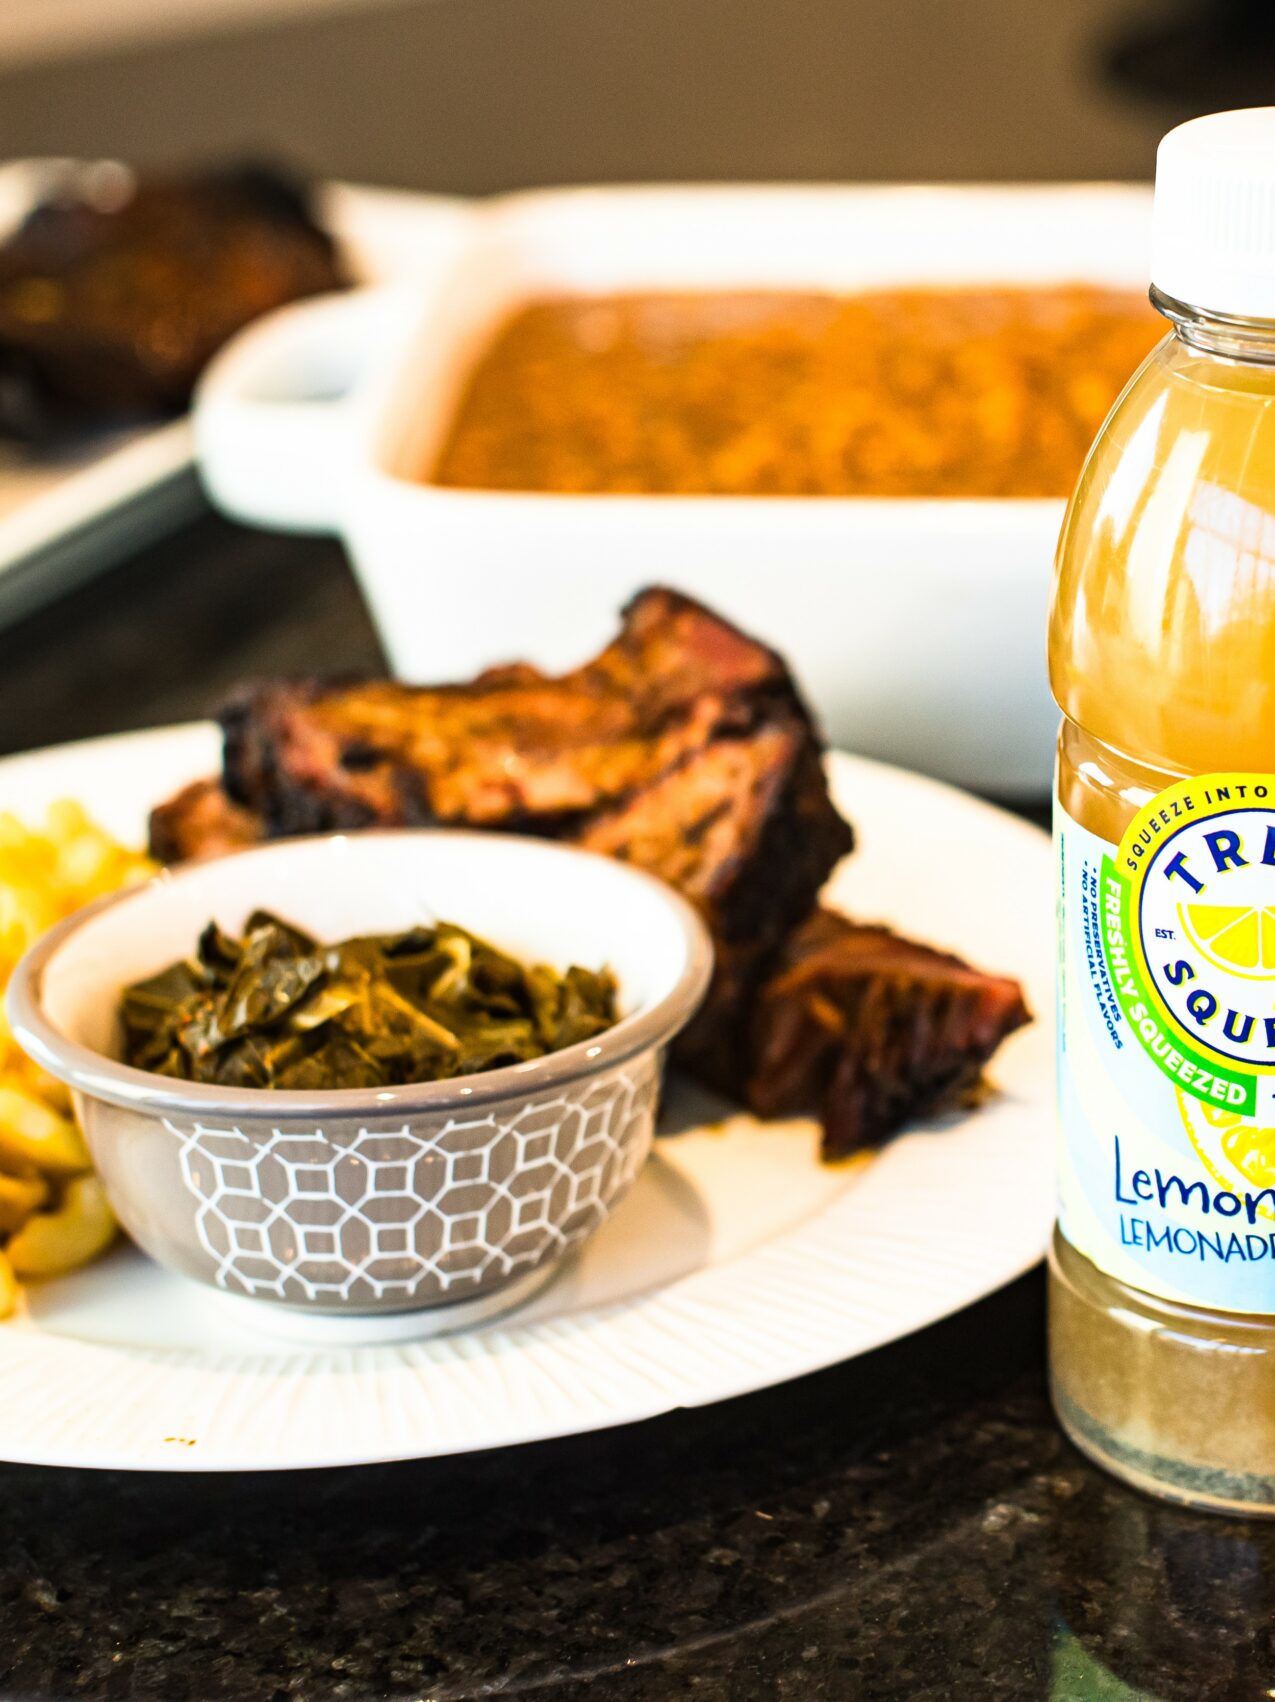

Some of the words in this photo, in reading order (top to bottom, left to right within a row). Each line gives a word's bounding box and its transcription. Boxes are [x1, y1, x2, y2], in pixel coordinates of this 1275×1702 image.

[1127, 796, 1195, 871] SQUEEZE
[1205, 785, 1268, 804] INTO
[1081, 868, 1088, 891] NO
[1090, 876, 1097, 899] NO
[1082, 898, 1097, 980] ARTIFICIAL
[1091, 903, 1122, 1023] PRESERVATIVES
[1155, 928, 1176, 941] EST.
[1093, 983, 1124, 1050] FLAVORS
[1104, 876, 1140, 998] FRESHLY
[1129, 1002, 1248, 1106] SQUEEZED
